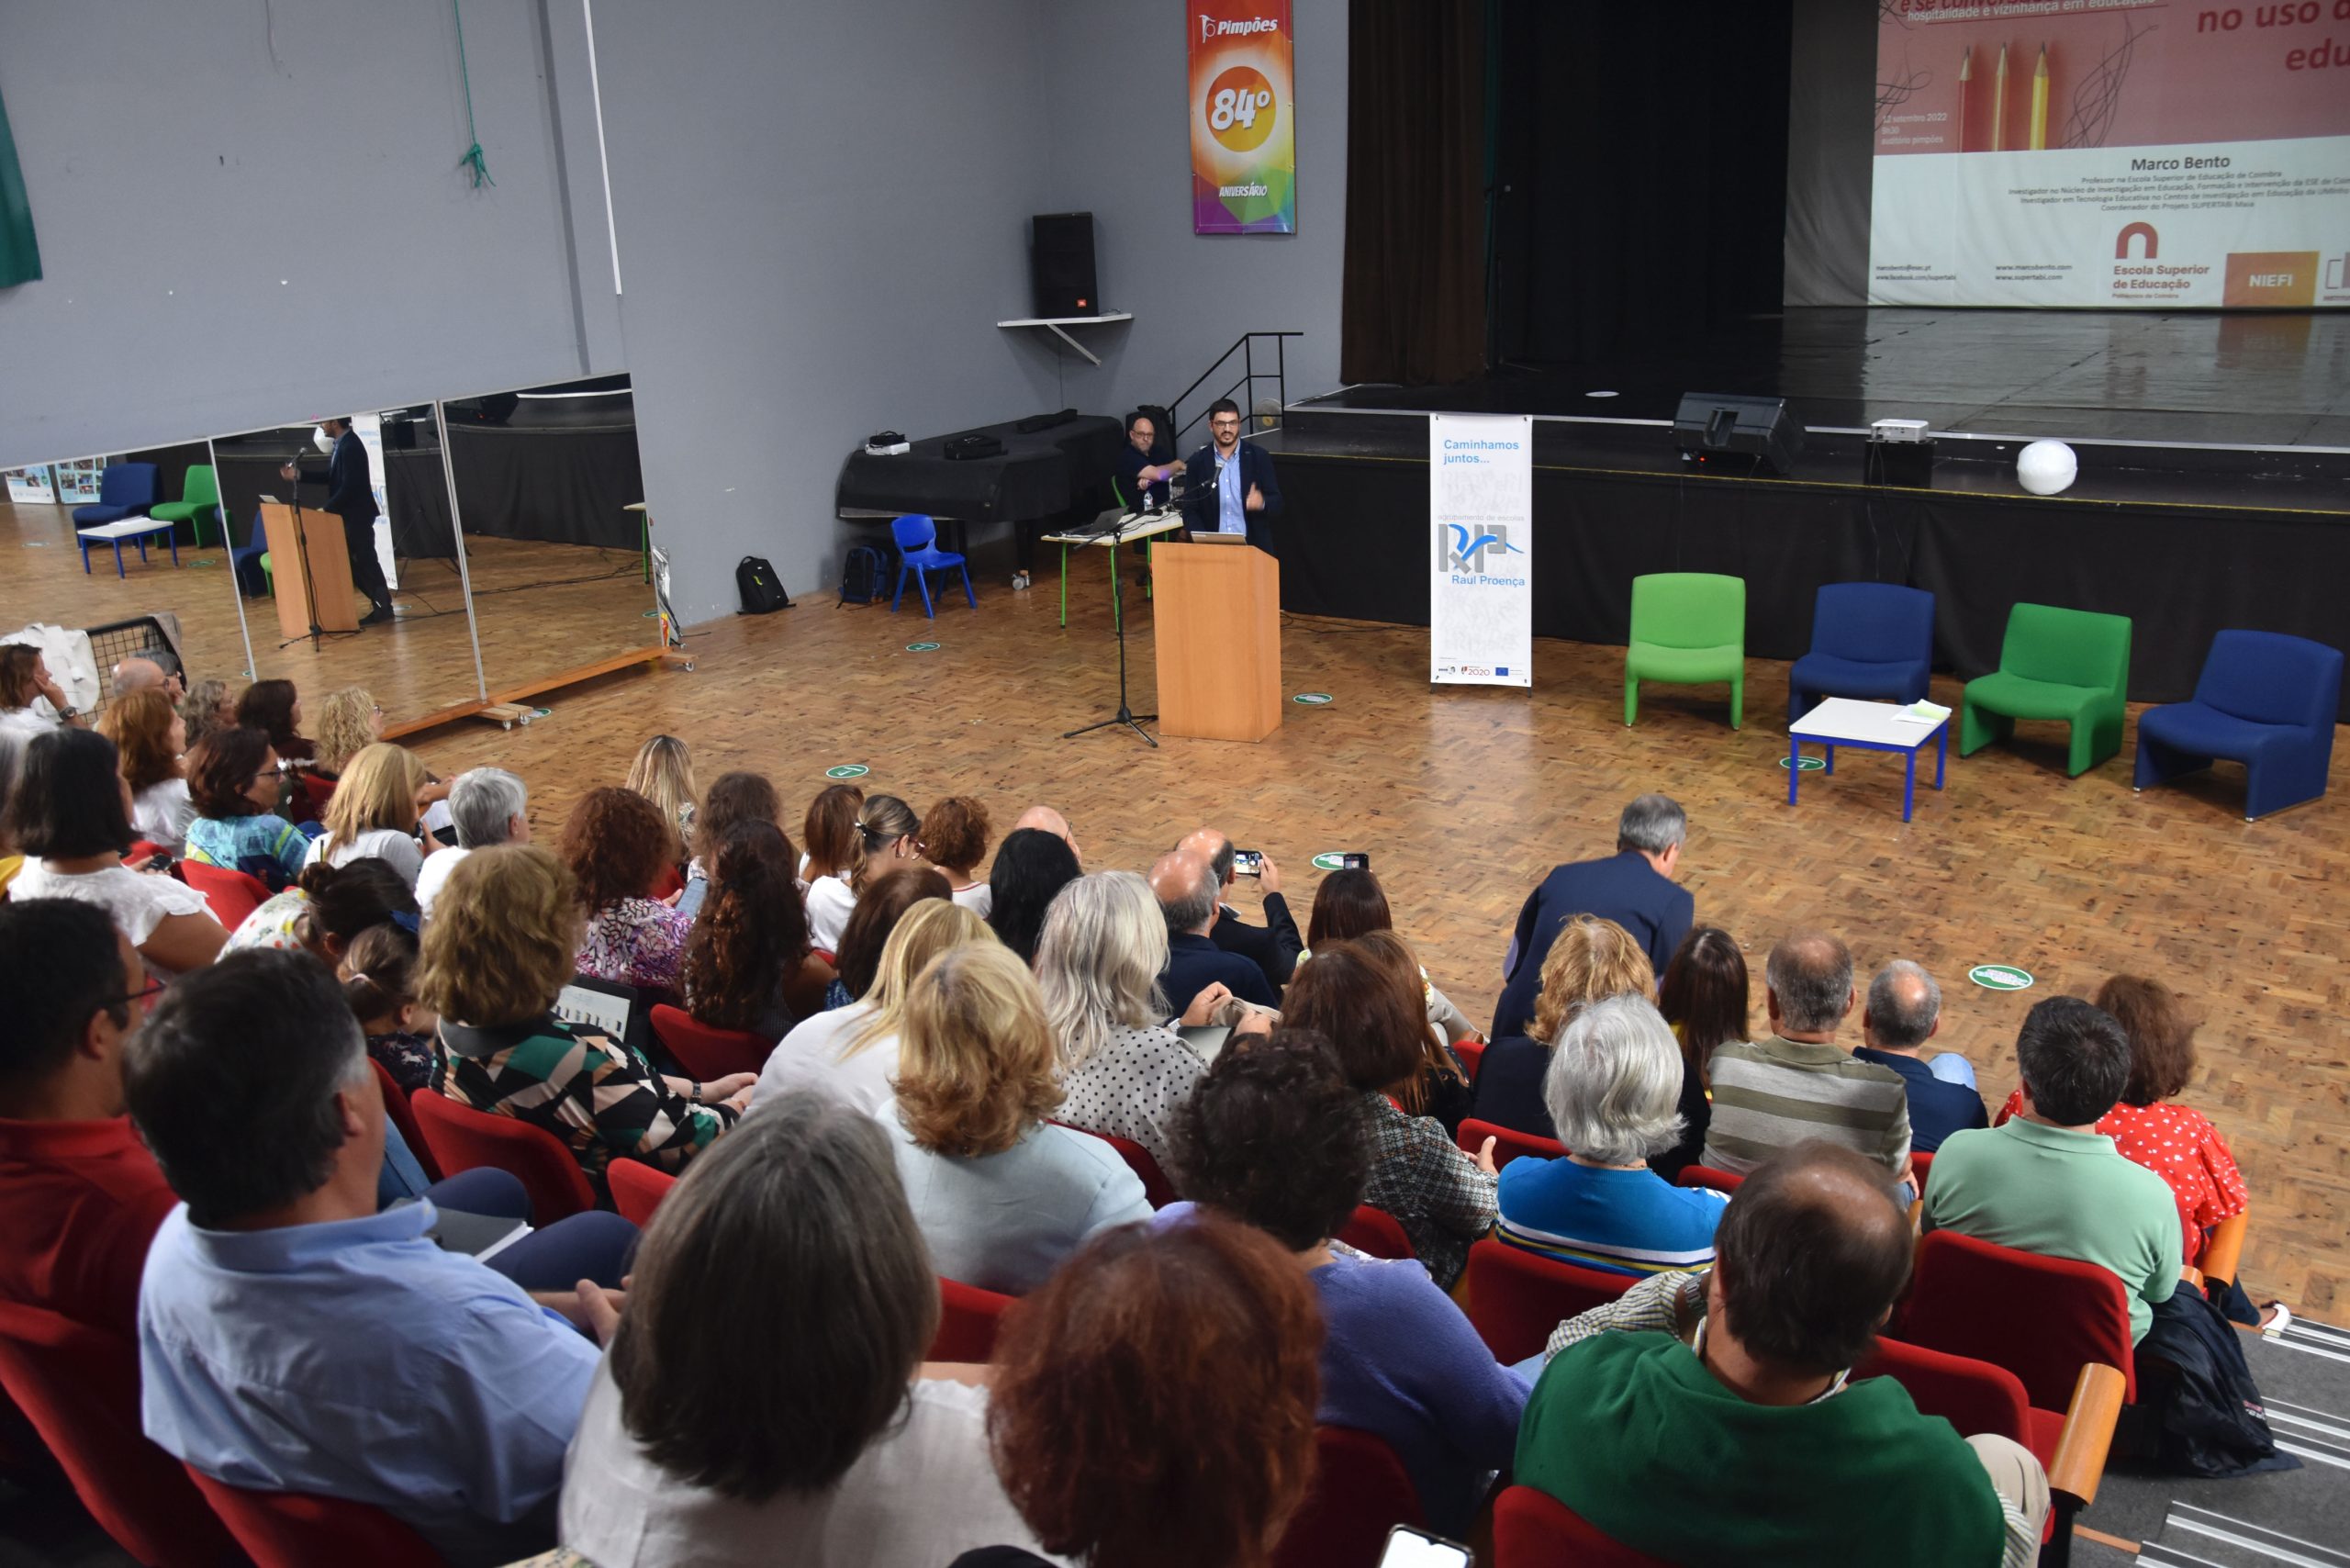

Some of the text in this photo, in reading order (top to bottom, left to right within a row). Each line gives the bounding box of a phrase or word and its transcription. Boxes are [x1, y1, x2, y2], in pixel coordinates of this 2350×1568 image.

[1908, 7, 1980, 22] hospitalidade
[1983, 6, 1990, 16] e
[1994, 1, 2059, 16] vizinhança
[2064, 0, 2084, 10] em
[2198, 8, 2243, 33] no
[2255, 1, 2321, 28] uso
[1217, 17, 1278, 36] Pimpões
[2286, 38, 2350, 71] edu
[2131, 156, 2230, 171] Marco Bento
[2153, 174, 2185, 183] Superior
[1219, 182, 1267, 197] ANIVERSÁRIO
[2113, 264, 2210, 276] Escola Superior
[2113, 279, 2190, 291] de Educação
[2249, 274, 2293, 287] NIEFI
[1444, 440, 1519, 450] Caminhamos
[1443, 454, 1490, 465] juntos...
[1451, 575, 1525, 588] Raul Proença
[1468, 668, 1490, 677] 2020
